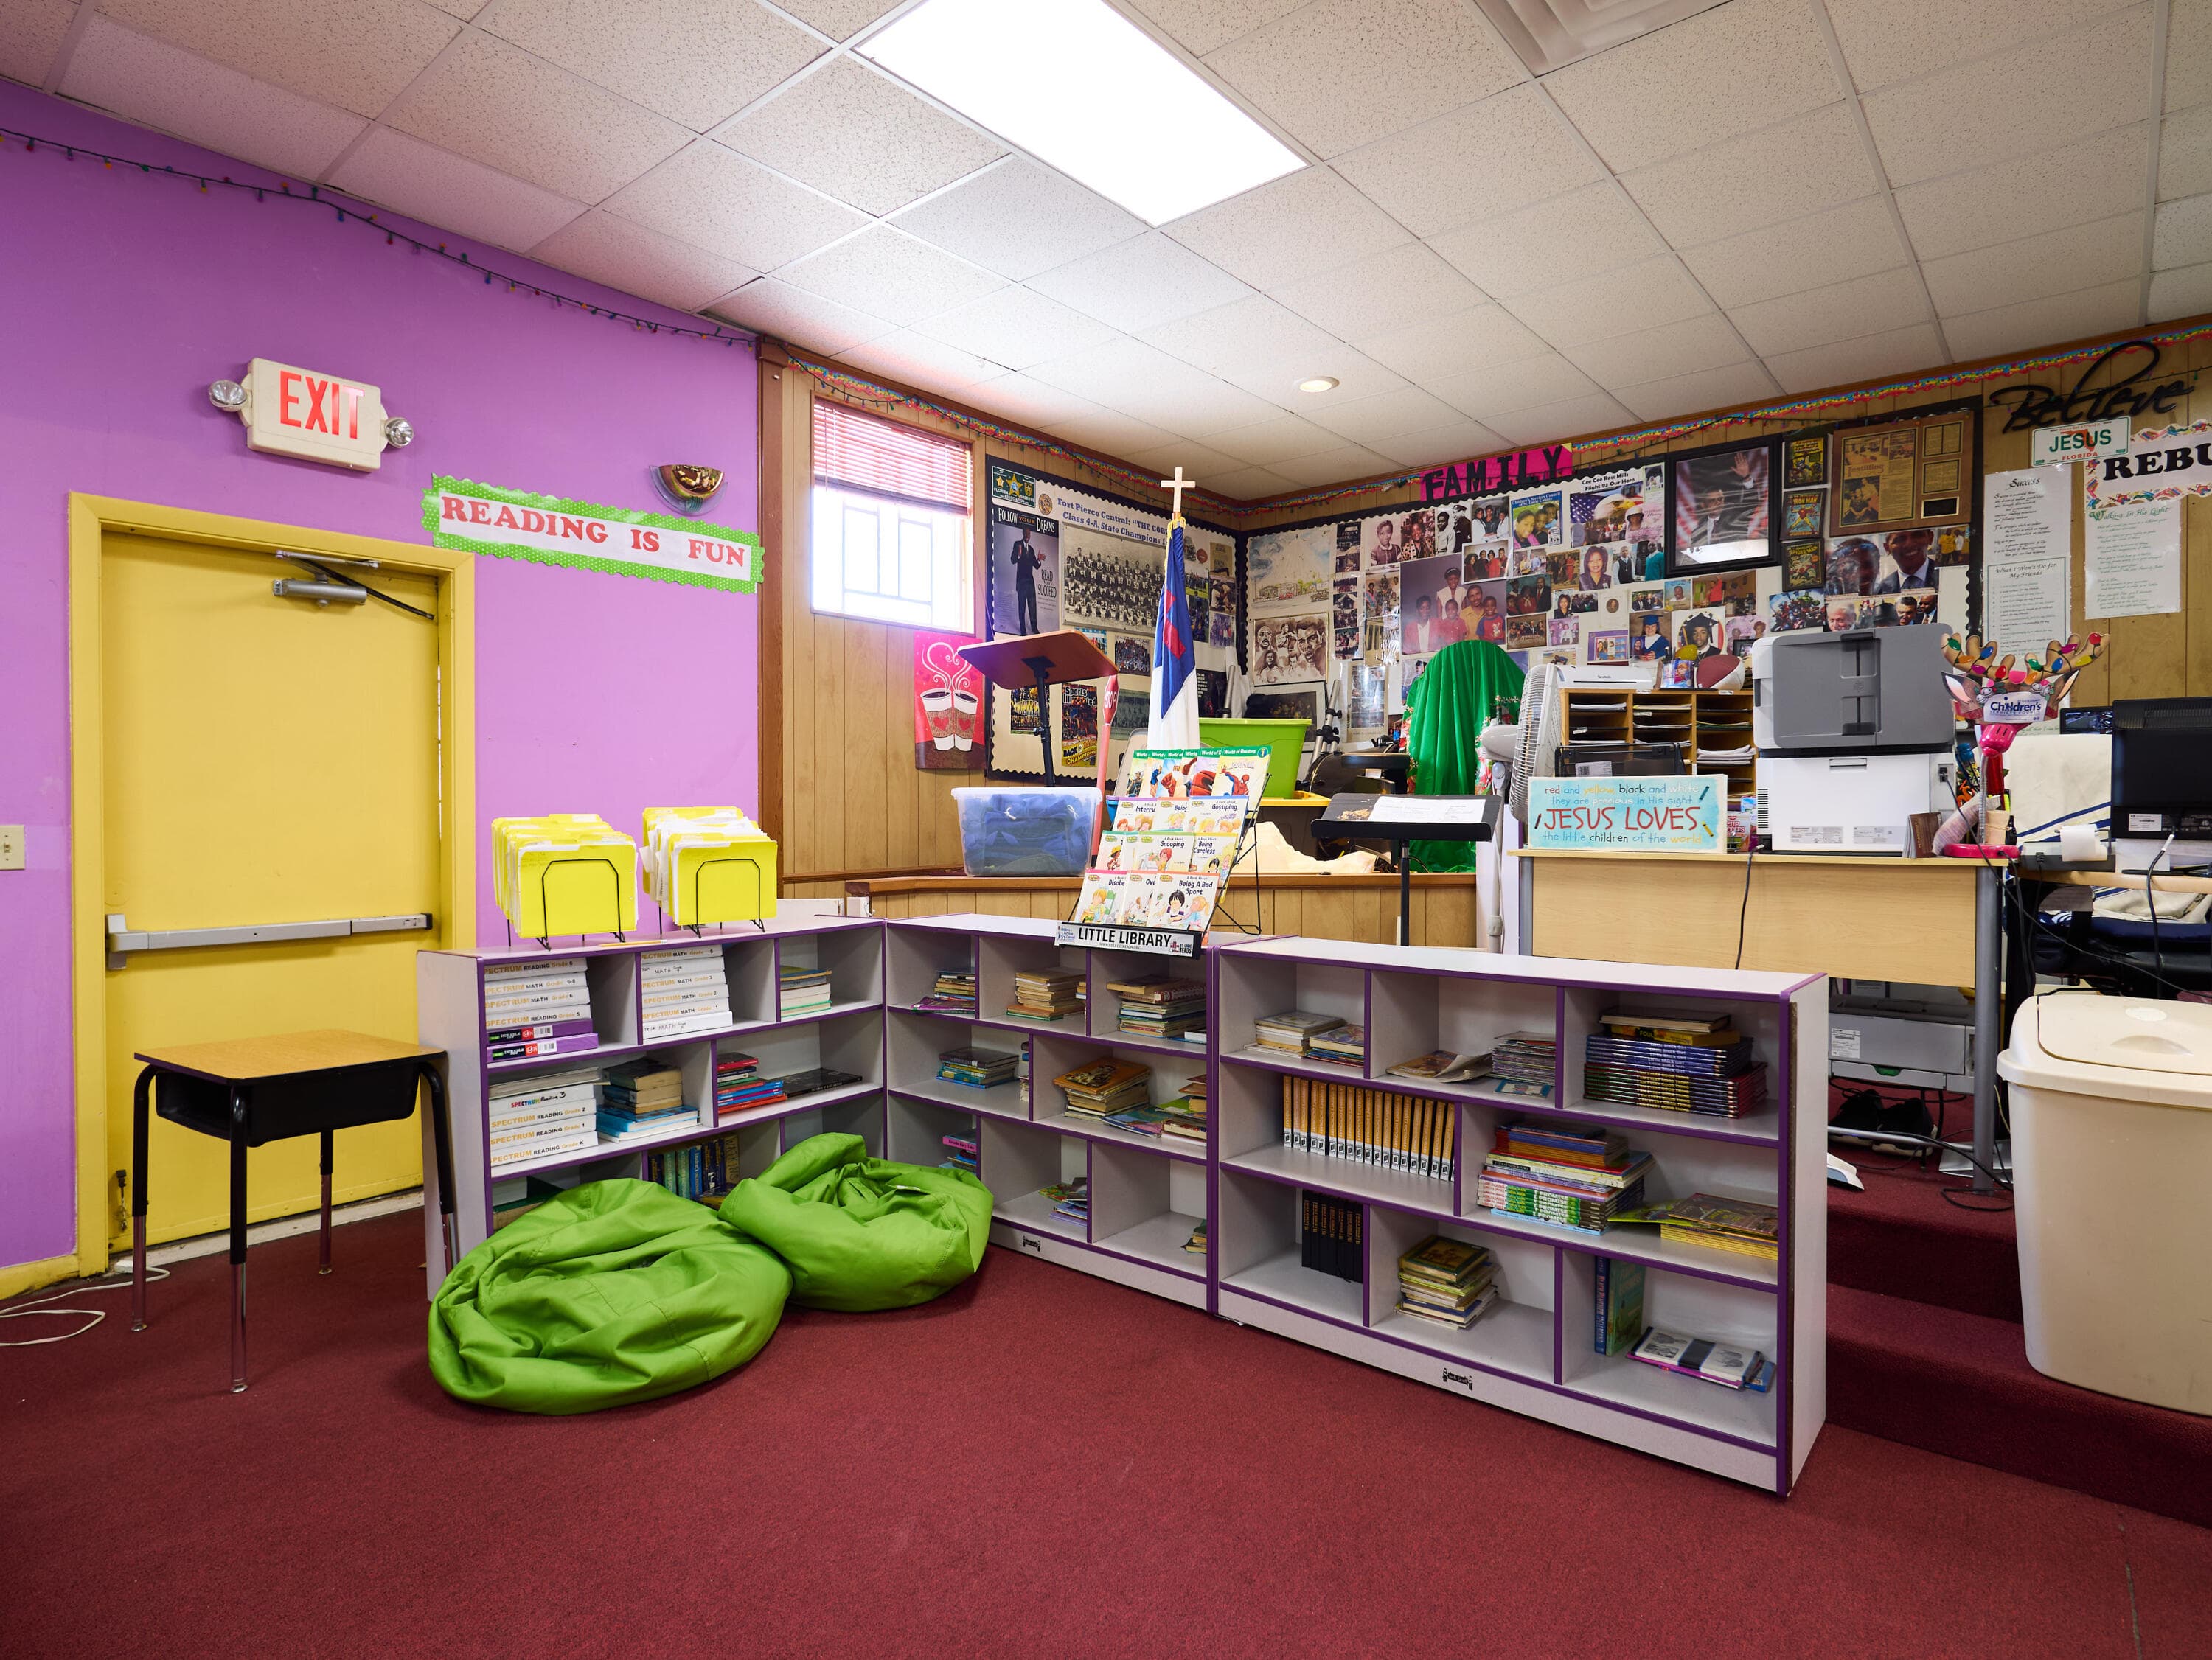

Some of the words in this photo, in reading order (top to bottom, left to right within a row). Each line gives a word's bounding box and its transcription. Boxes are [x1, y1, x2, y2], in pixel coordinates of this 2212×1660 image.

[1989, 341, 2195, 433] Believe
[279, 371, 365, 439] EXIT
[2049, 429, 2111, 453] JESUS
[2062, 452, 2098, 461] FLORIDA
[1424, 445, 1563, 501] FAMILY
[1057, 498, 1074, 509] Fort
[1075, 503, 1099, 517] Pierce
[1101, 511, 1130, 525] Central:
[2089, 510, 2123, 521] Walking
[998, 508, 1018, 523] FOLLOW
[1018, 515, 1035, 524] YOUR
[1037, 517, 1055, 533] DREAMS
[440, 495, 608, 544] READING
[630, 529, 660, 552] IS
[687, 537, 745, 568] FUN
[1062, 512, 1085, 524] Class
[1101, 523, 1119, 534] State
[1121, 529, 1161, 545] Champions
[1041, 569, 1053, 583] READ
[1037, 584, 1057, 598] SUCCEED
[1065, 687, 1088, 697] Sports
[1105, 691, 1117, 708] STOP
[1990, 697, 2042, 712] Children's
[1063, 746, 1077, 757] BACK
[1545, 784, 1560, 795] red
[1564, 784, 1580, 795] and
[1619, 781, 1645, 794] black
[1649, 784, 1666, 794] and
[1668, 783, 1699, 794] white
[1551, 795, 1571, 806] they
[1593, 796, 1634, 806] precious
[1637, 795, 1644, 804] in
[1649, 796, 1663, 804] His
[1667, 795, 1692, 807] sight
[1544, 807, 1615, 830] JESUS
[1624, 806, 1700, 831] LOVES
[1161, 840, 1185, 848] Snooping
[1198, 840, 1213, 848] Being
[1543, 831, 1559, 843] the
[1562, 831, 1586, 843] little
[1589, 831, 1628, 843] children
[1632, 832, 1646, 843] of
[1648, 831, 1666, 843] the
[1669, 833, 1702, 844] world
[1178, 880, 1194, 888] Being
[1078, 927, 1116, 943] LITTLE
[1119, 931, 1172, 948] LIBRARY
[484, 965, 522, 974] PECTRUM
[485, 984, 524, 994] PECTRUM
[485, 997, 529, 1009] SPECTRUM
[644, 995, 681, 1004] SPECTRUM
[486, 1016, 530, 1027] SPECTRUM
[642, 1011, 679, 1019] SPECTRUM
[511, 1098, 540, 1109] SPECTRUM
[492, 1115, 535, 1128] SPECTRUM
[537, 1112, 563, 1120] READING
[490, 1131, 535, 1145] SPECTRUM
[536, 1128, 563, 1137] READING
[490, 1151, 532, 1163] PECTRUM
[533, 1145, 560, 1155] READING
